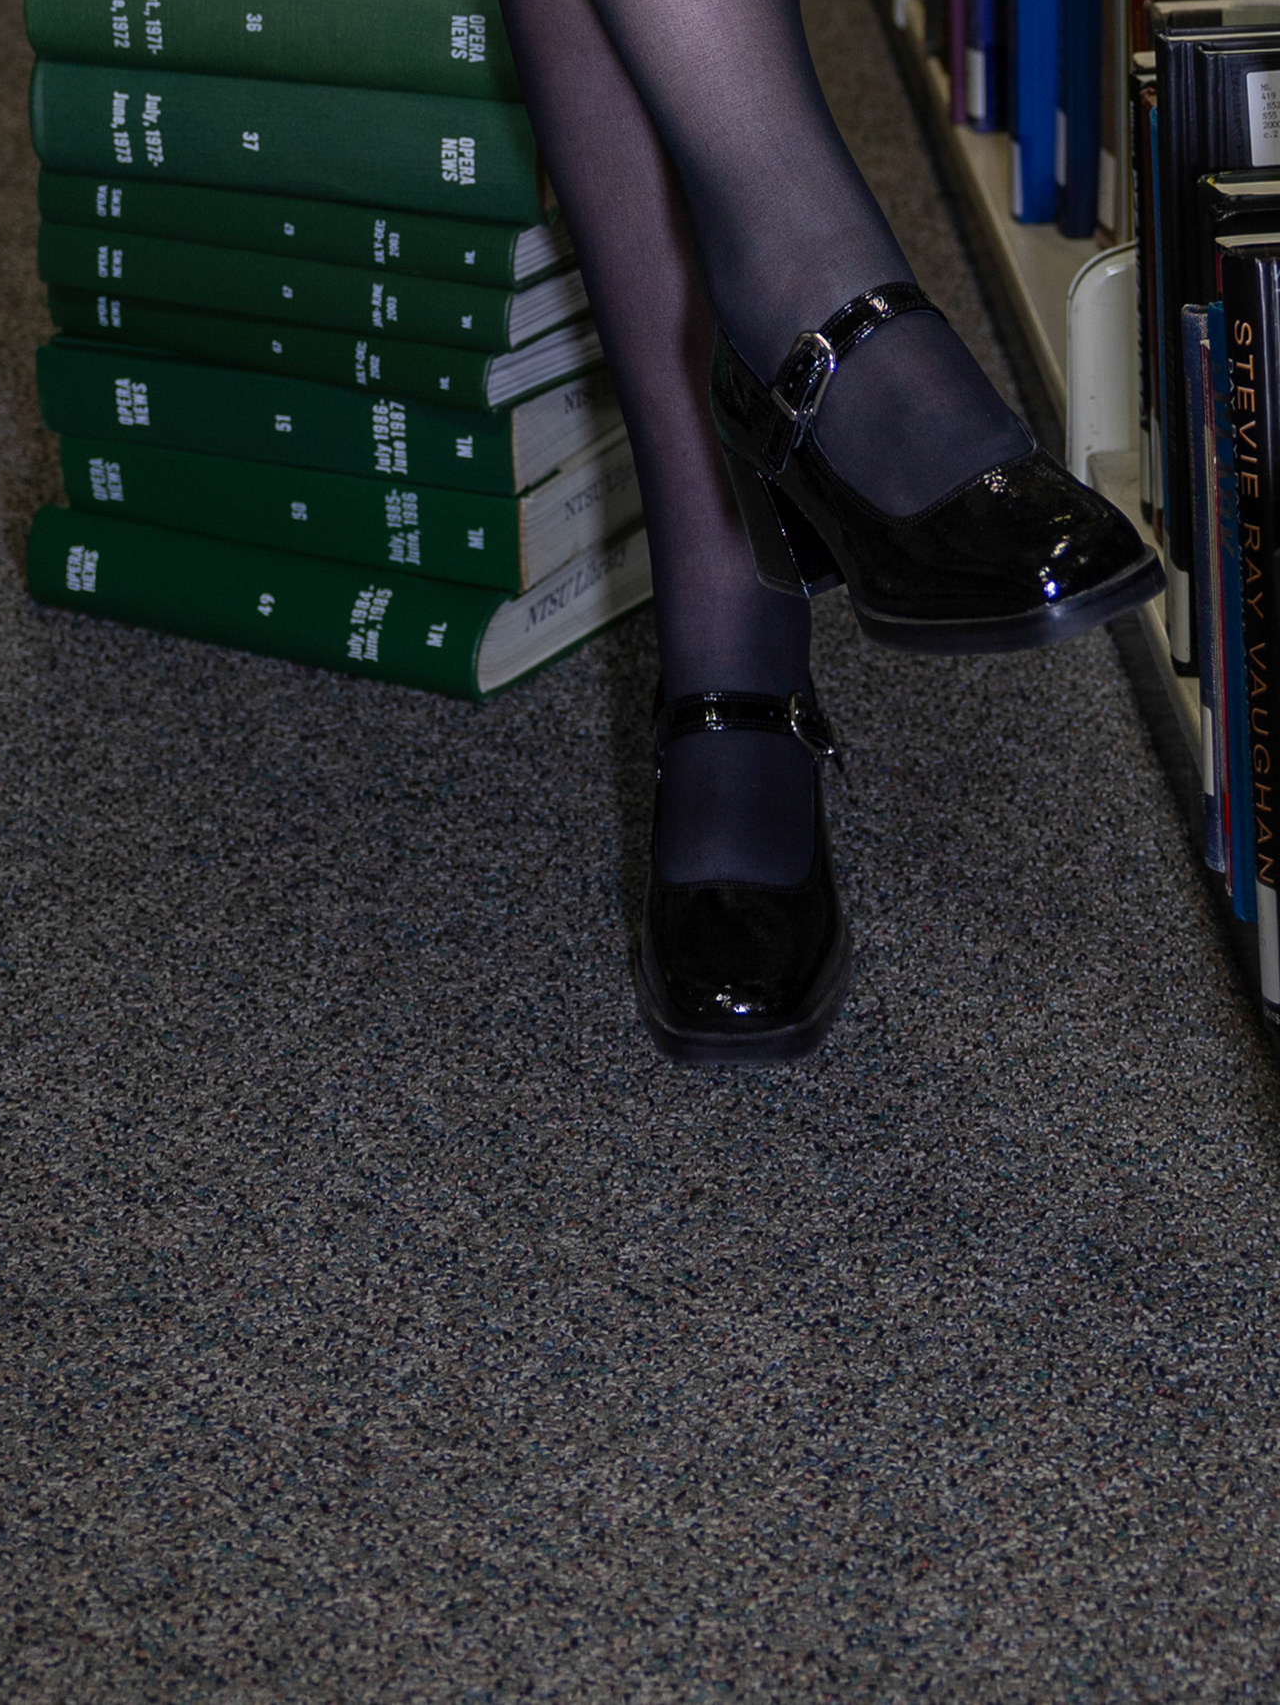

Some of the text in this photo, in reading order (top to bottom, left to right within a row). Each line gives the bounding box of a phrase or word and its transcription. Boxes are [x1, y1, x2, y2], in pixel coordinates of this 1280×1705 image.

[112, 14, 131, 49] 1972
[145, 17, 164, 55] 1971-
[245, 12, 263, 33] 36
[451, 14, 469, 60] NEWS
[468, 14, 486, 63] OPERA
[1261, 92, 1276, 100] 419
[109, 91, 133, 164] June, 1973
[142, 93, 165, 167] July, 1972-
[242, 131, 260, 152] 37
[441, 137, 459, 183] NEWS
[458, 136, 476, 186] OPERA
[96, 185, 108, 217] OPERA
[111, 188, 122, 217] NEWS
[97, 245, 109, 278] OPERA
[112, 249, 123, 279] NEWS
[97, 296, 109, 327] OPERA
[111, 300, 122, 328] NEWS
[114, 378, 135, 426] OPERA
[131, 382, 151, 426] NEWS
[274, 414, 292, 433] 51
[372, 398, 393, 475] July 1986-
[389, 400, 409, 475] June 1987
[456, 435, 474, 459] ML
[88, 457, 109, 502] OPERA
[104, 461, 124, 502] NEWS
[290, 501, 308, 522] 50
[385, 488, 407, 565] July, 1985-
[401, 490, 421, 566] June, 1986
[467, 526, 485, 550] ML
[66, 545, 85, 592] OPERA
[81, 549, 100, 593] NEWS
[256, 592, 276, 617] 49
[524, 584, 570, 633] NTSU
[1232, 319, 1275, 887] STEVIE RAY VAUGHAN
[346, 626, 366, 662] July,
[363, 587, 394, 663] June, 1985
[425, 621, 448, 648] ML
